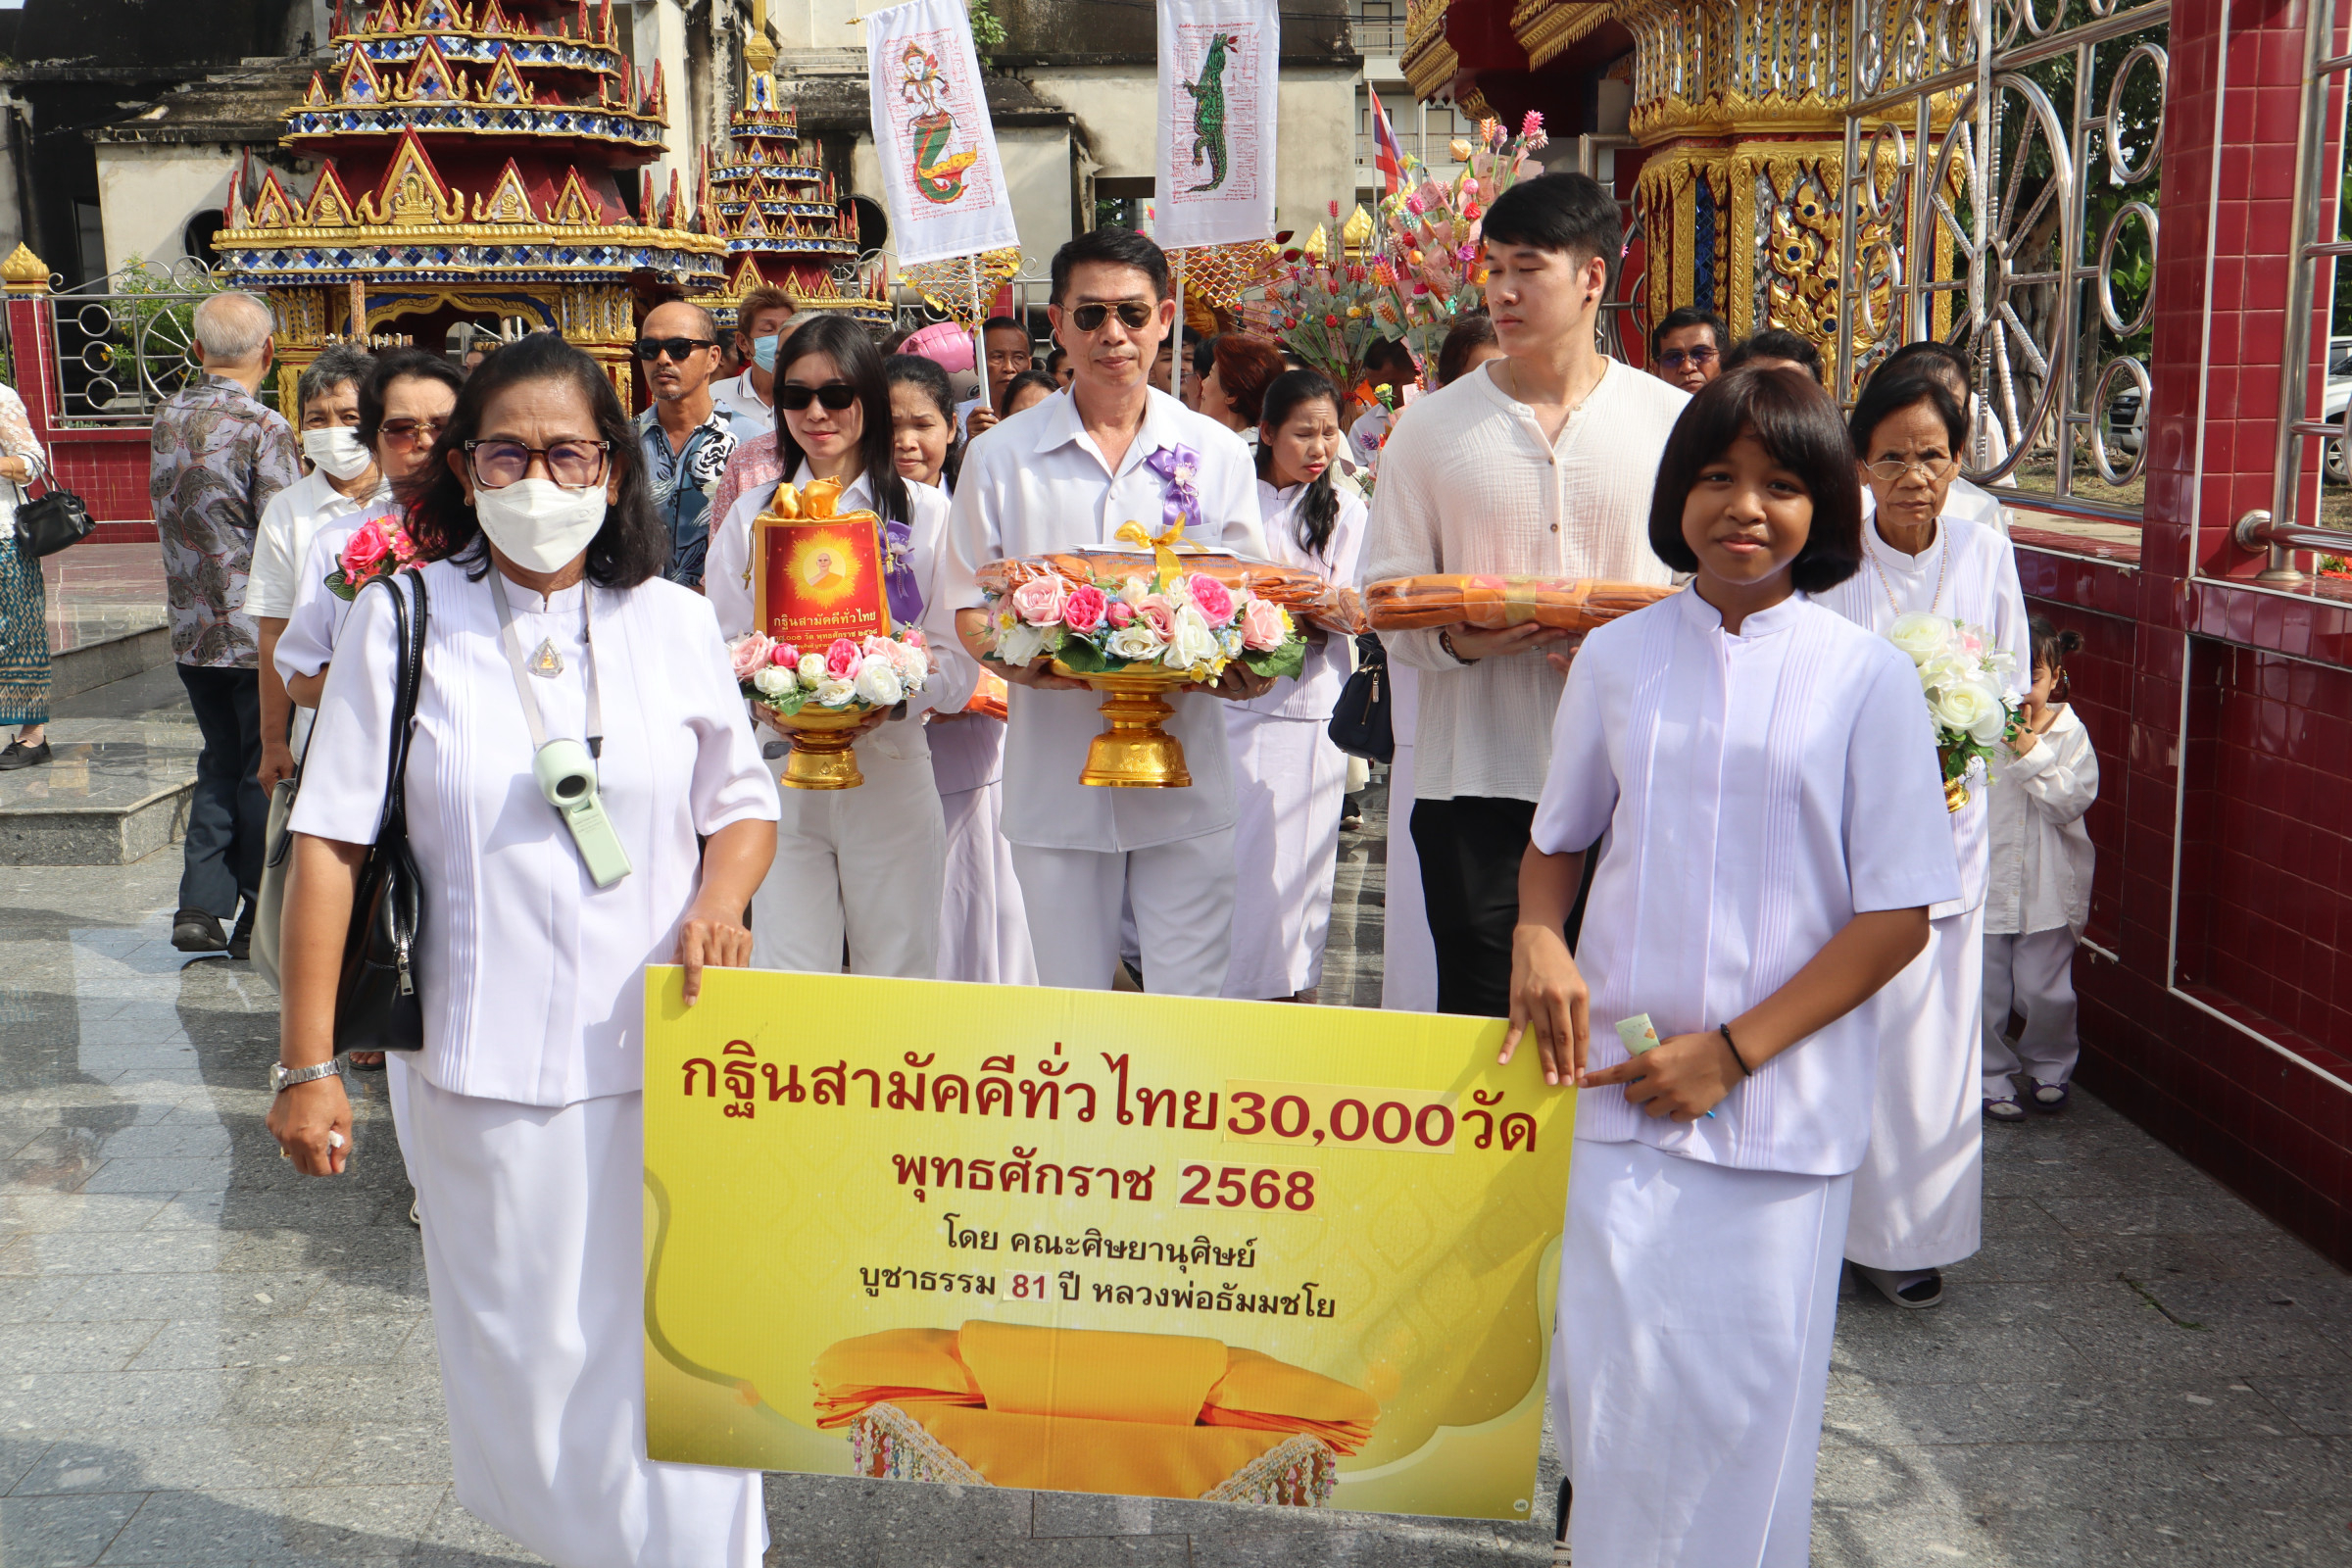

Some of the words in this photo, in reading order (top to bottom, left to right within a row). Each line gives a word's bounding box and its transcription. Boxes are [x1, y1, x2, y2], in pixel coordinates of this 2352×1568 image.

[773, 607, 877, 630] กฐินสามัคคีทั่วไทย
[891, 1145, 1156, 1203] พุทธศักราช
[1179, 1164, 1315, 1212] 2568
[943, 1213, 999, 1250] โดย
[1010, 1227, 1258, 1274] คณะศิษยานุศิษย์
[859, 1266, 997, 1298] บูชาธรรม
[1011, 1273, 1047, 1300] 81
[1057, 1269, 1081, 1301] ปี
[1092, 1280, 1336, 1318] หลวงพ่อธัมมชโย
